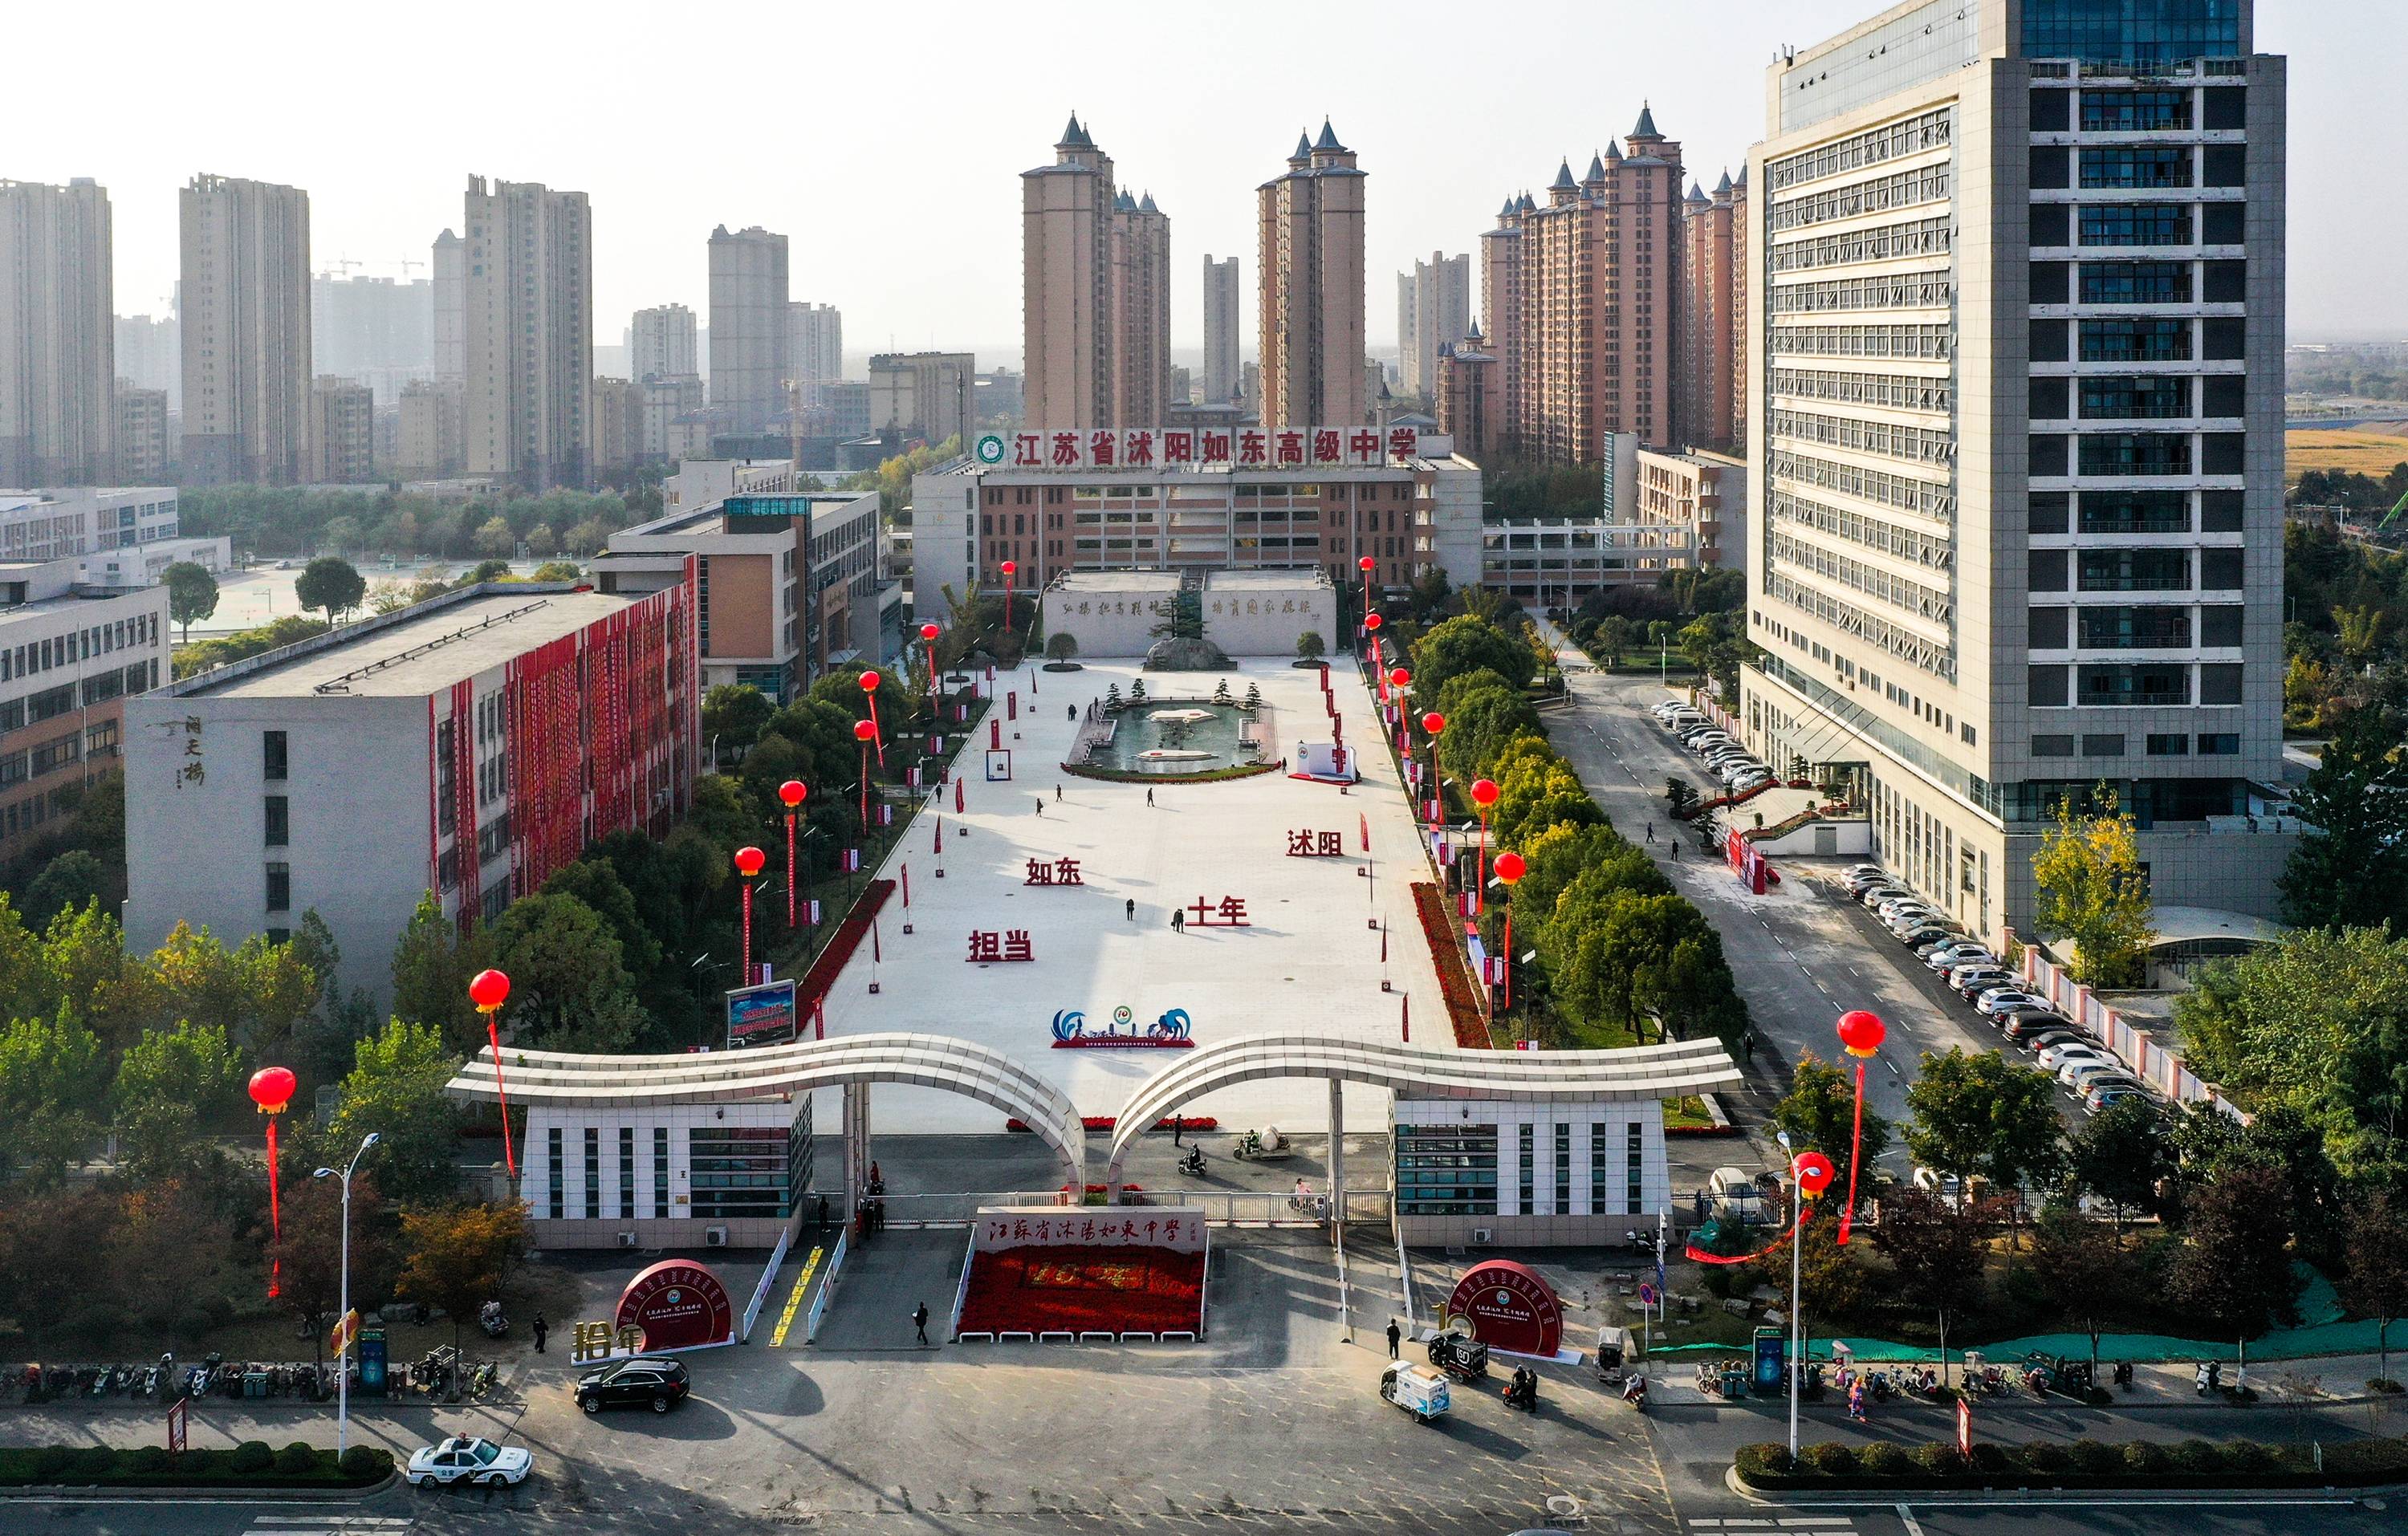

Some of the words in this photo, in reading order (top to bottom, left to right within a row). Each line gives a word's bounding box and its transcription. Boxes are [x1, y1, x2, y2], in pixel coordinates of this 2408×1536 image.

[1015, 428, 1417, 466] 江苏省沭阳如东高级中学
[1287, 829, 1342, 855] 沭阳
[1026, 857, 1082, 884] 如东
[1187, 895, 1247, 924] 十年
[969, 929, 1032, 961] 担当
